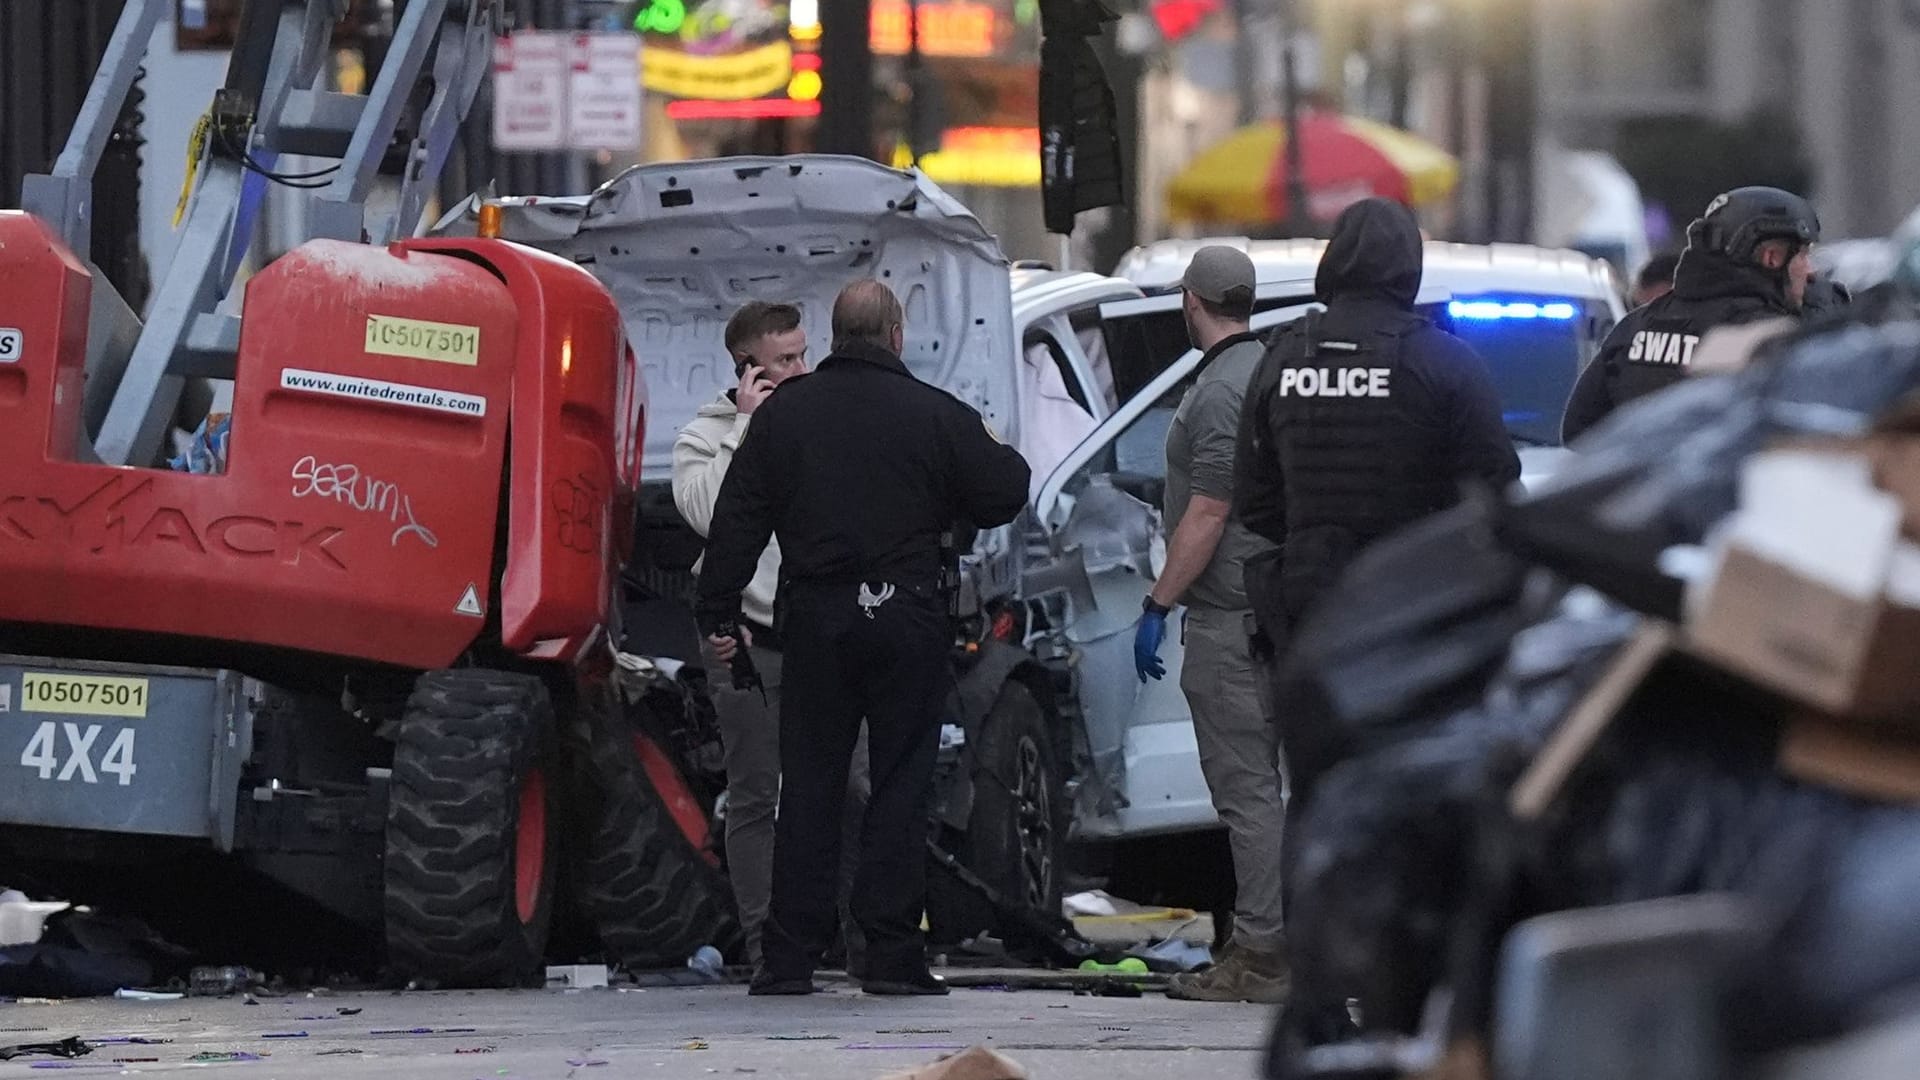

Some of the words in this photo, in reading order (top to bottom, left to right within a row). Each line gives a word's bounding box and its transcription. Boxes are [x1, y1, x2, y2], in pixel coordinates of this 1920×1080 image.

[368, 319, 475, 354] 10507501
[1628, 330, 1700, 365] SWAT
[286, 375, 481, 413] www.unitedrentals.com
[1280, 367, 1391, 397] POLICE
[24, 680, 145, 706] 10507501
[21, 721, 137, 786] 4X4
